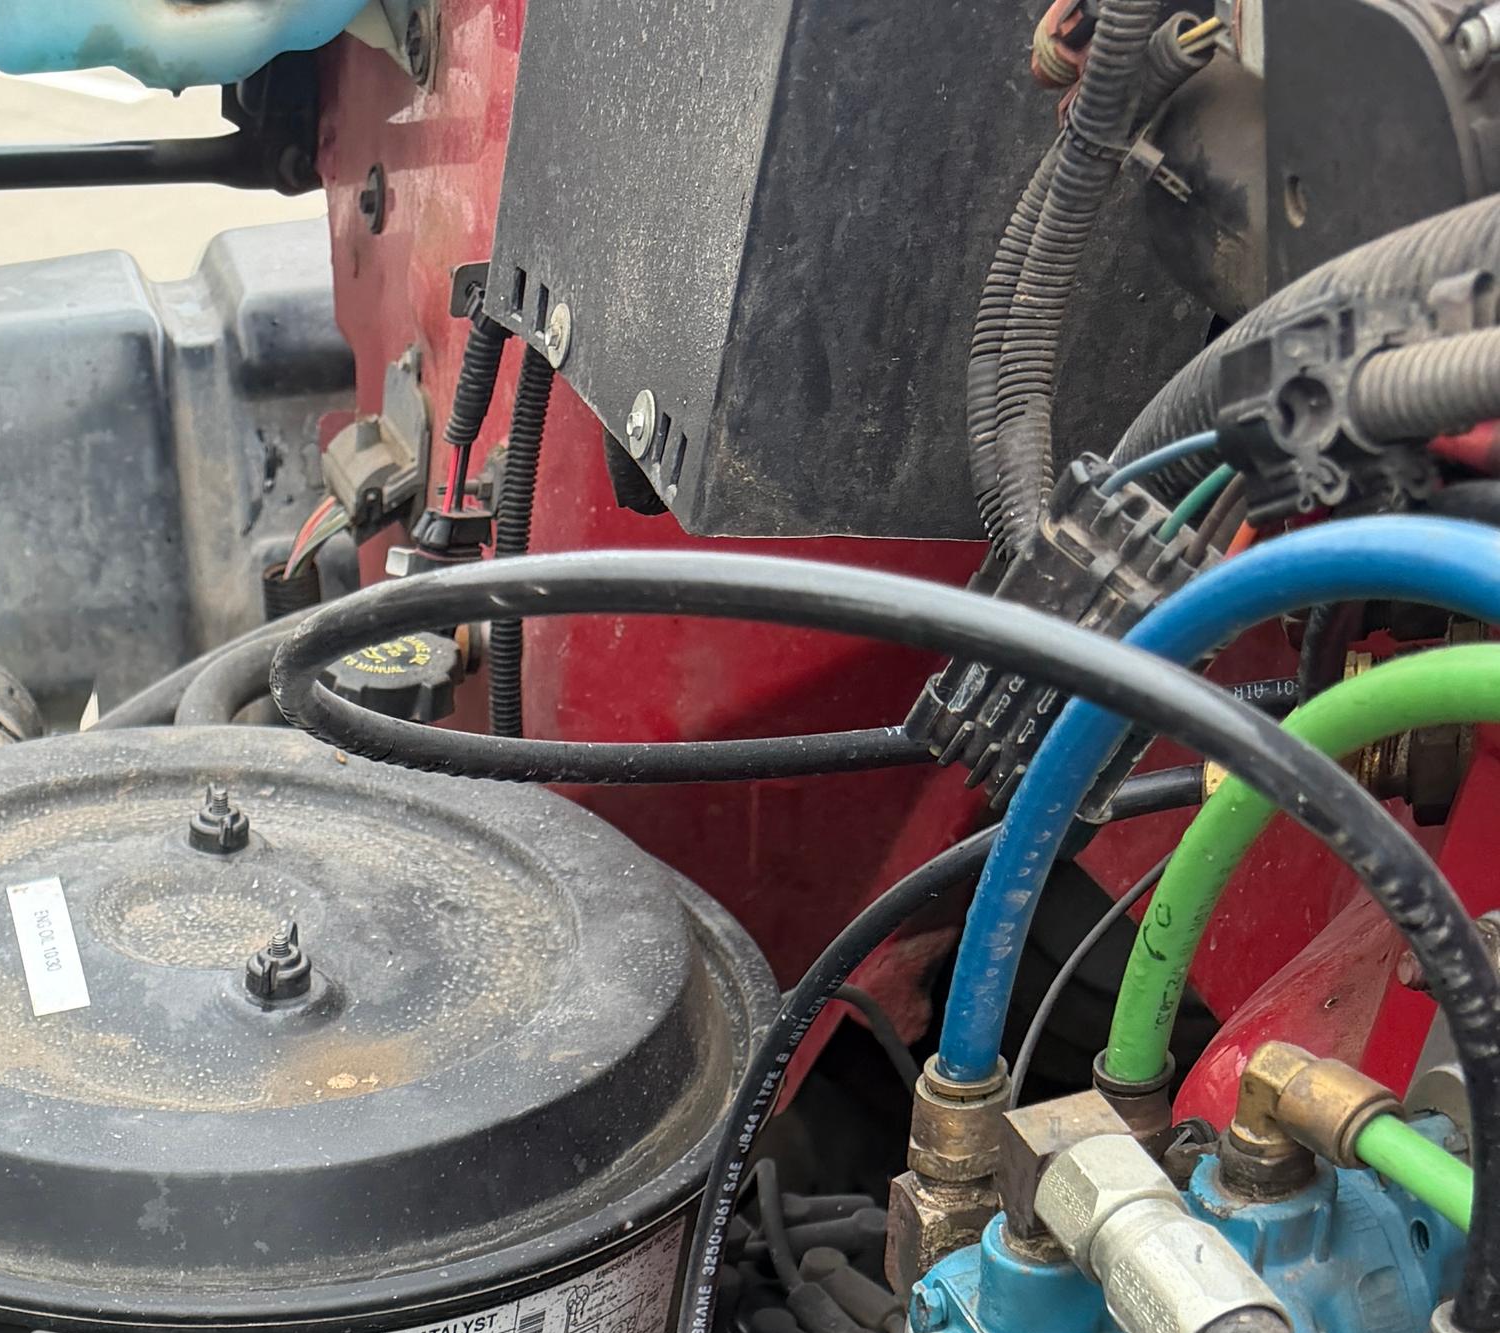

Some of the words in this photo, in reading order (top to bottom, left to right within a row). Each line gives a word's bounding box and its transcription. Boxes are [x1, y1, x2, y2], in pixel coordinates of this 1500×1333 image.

[355, 662, 406, 674] MANUAL
[701, 1197, 733, 1277] 3250-061
[723, 1159, 743, 1193] SAE
[739, 1113, 760, 1155] J844
[753, 1068, 782, 1107] TYPE
